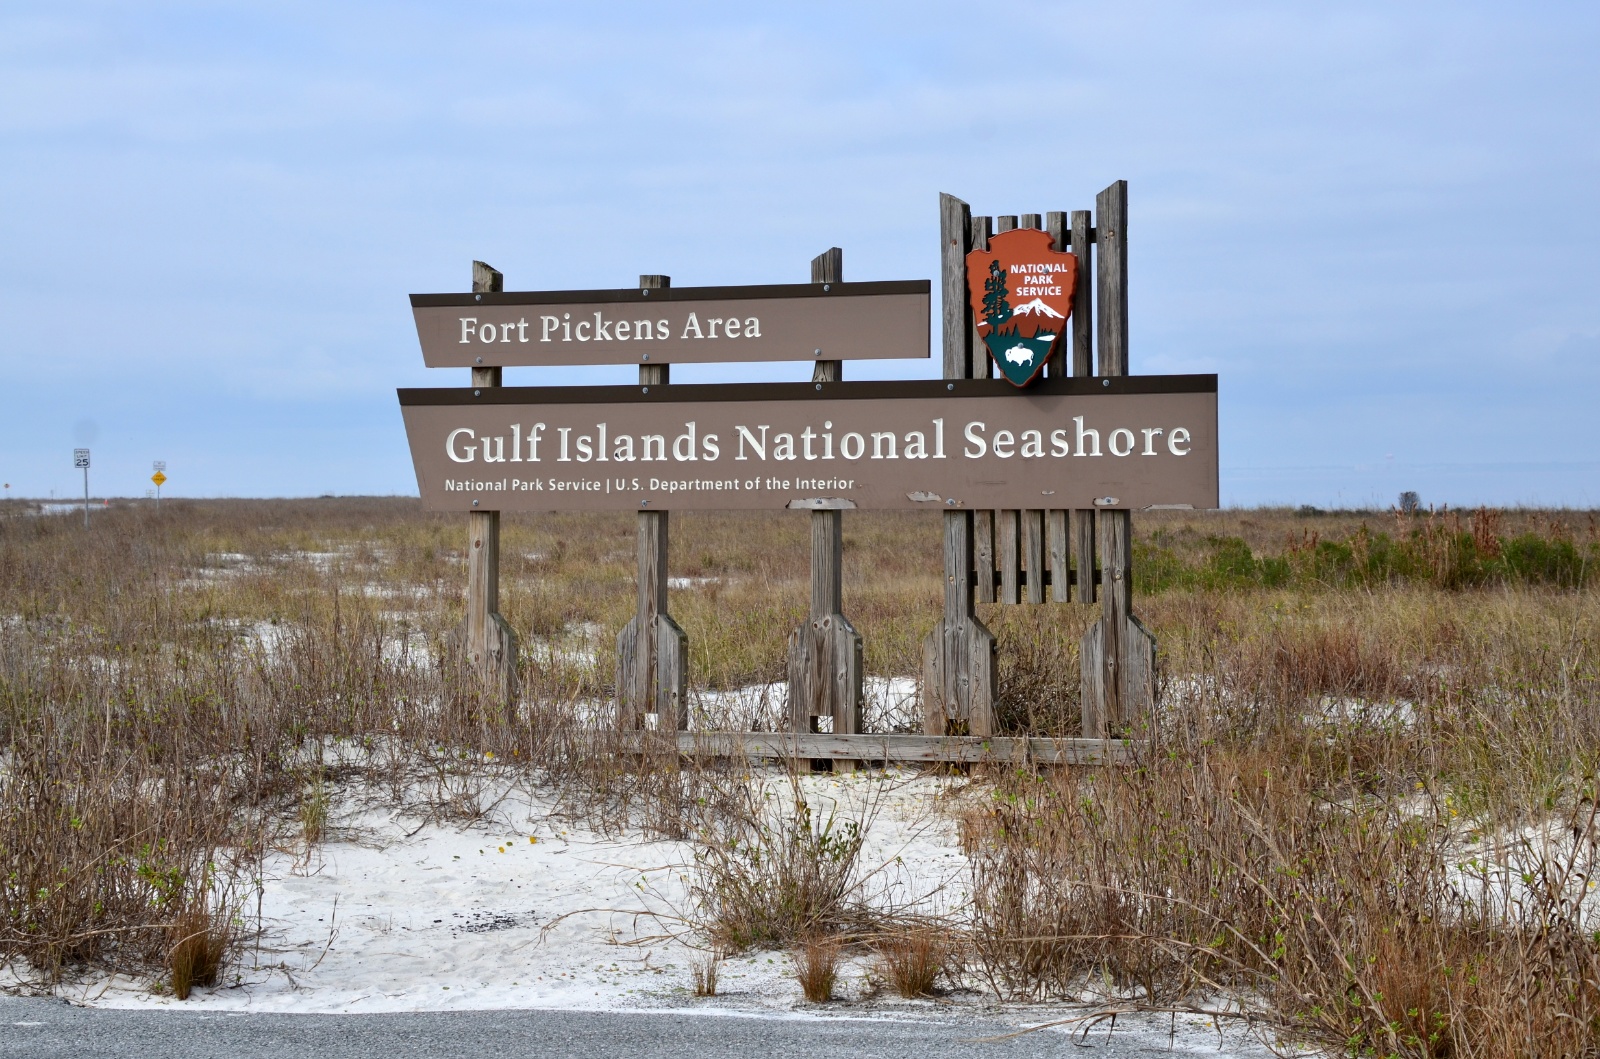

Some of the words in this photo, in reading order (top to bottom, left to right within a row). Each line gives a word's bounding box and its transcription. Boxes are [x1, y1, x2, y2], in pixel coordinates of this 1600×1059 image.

[1010, 263, 1068, 274] NATIONAL
[1024, 274, 1054, 285] PARK
[1016, 286, 1062, 297] SERVICE
[458, 316, 529, 344] Fort
[540, 311, 670, 342] Pickens
[680, 311, 762, 339] Area
[445, 422, 546, 463] Gulf
[556, 421, 720, 462] Islands
[735, 417, 947, 461] National
[964, 415, 1192, 459] Seashore
[445, 478, 507, 492] National
[511, 478, 544, 491] Park
[548, 477, 601, 491] Service
[615, 478, 644, 491] U.S.
[649, 477, 740, 494] Department
[744, 477, 761, 490] of
[765, 477, 791, 490] the
[795, 476, 855, 490] Interior
